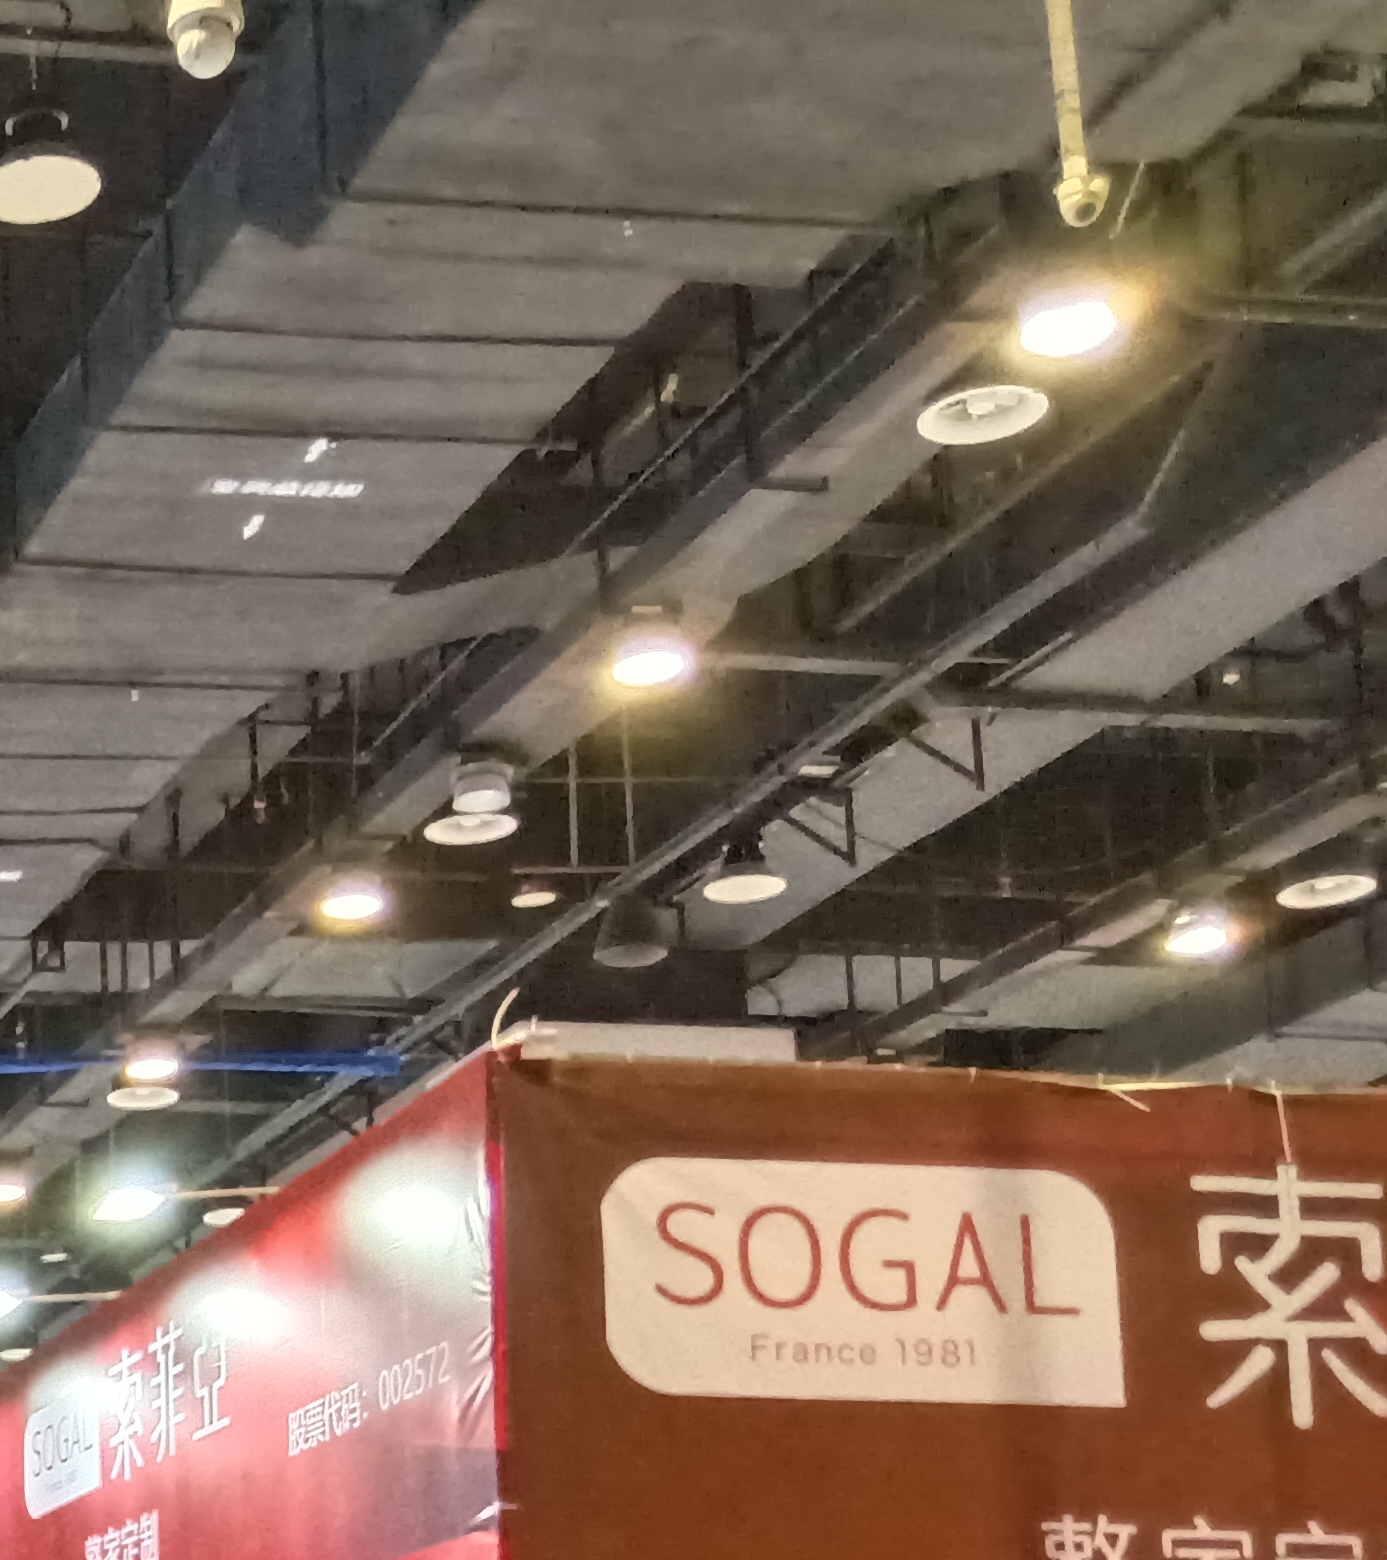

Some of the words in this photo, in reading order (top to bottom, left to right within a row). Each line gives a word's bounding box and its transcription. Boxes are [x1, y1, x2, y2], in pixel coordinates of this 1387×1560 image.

[654, 1201, 1081, 1317] SOGAL
[748, 1332, 877, 1366] France
[896, 1336, 978, 1368] 1981
[31, 1411, 93, 1478] SOGAL
